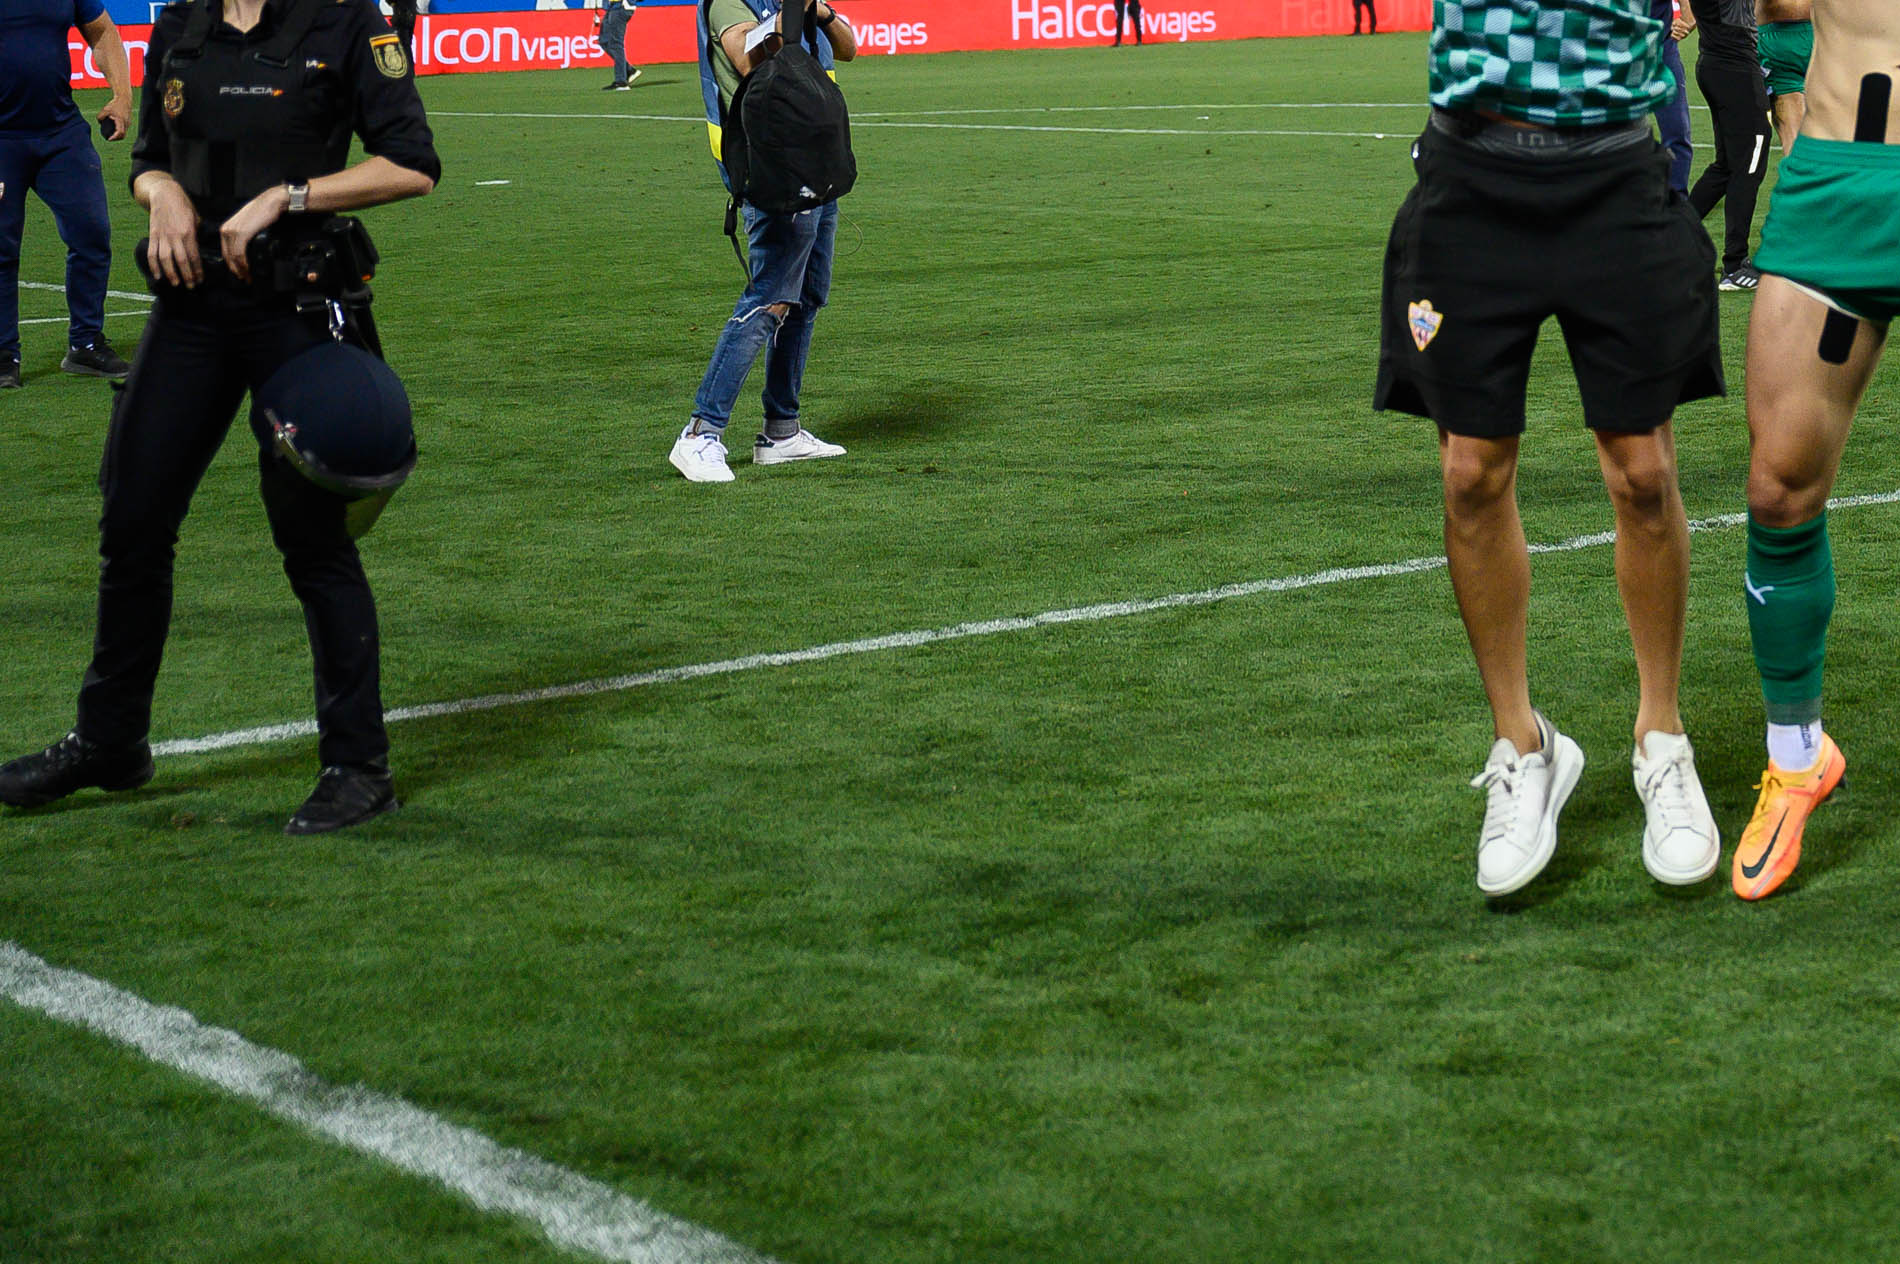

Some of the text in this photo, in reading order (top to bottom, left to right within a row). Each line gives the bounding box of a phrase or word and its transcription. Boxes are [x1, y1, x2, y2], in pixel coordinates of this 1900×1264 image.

[851, 21, 928, 55] viajes
[1146, 10, 1217, 42] viajes
[521, 34, 606, 69] viajes
[219, 86, 273, 96] POLICIA
